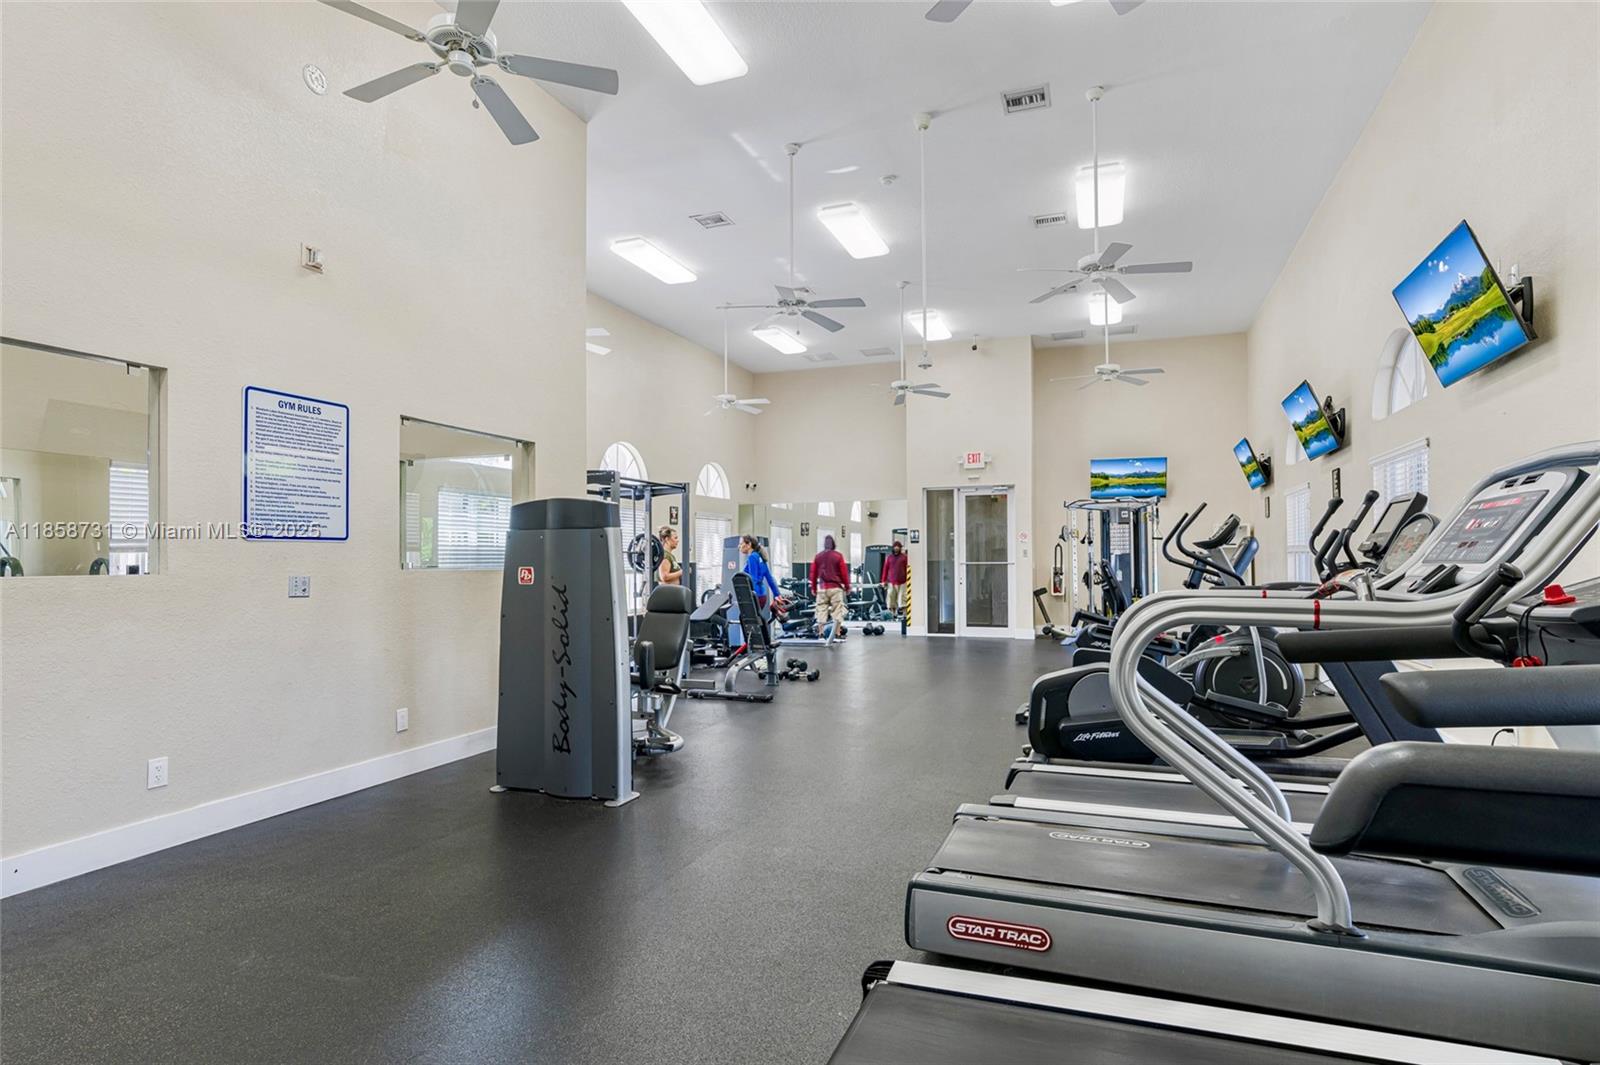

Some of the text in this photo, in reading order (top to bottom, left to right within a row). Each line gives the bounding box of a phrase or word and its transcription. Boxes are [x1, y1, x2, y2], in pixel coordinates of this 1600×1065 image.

[278, 400, 322, 415] GYM RULES
[967, 452, 981, 464] EXIT
[551, 584, 577, 755] Body-Solid
[954, 922, 1042, 944] STAR TRAC
